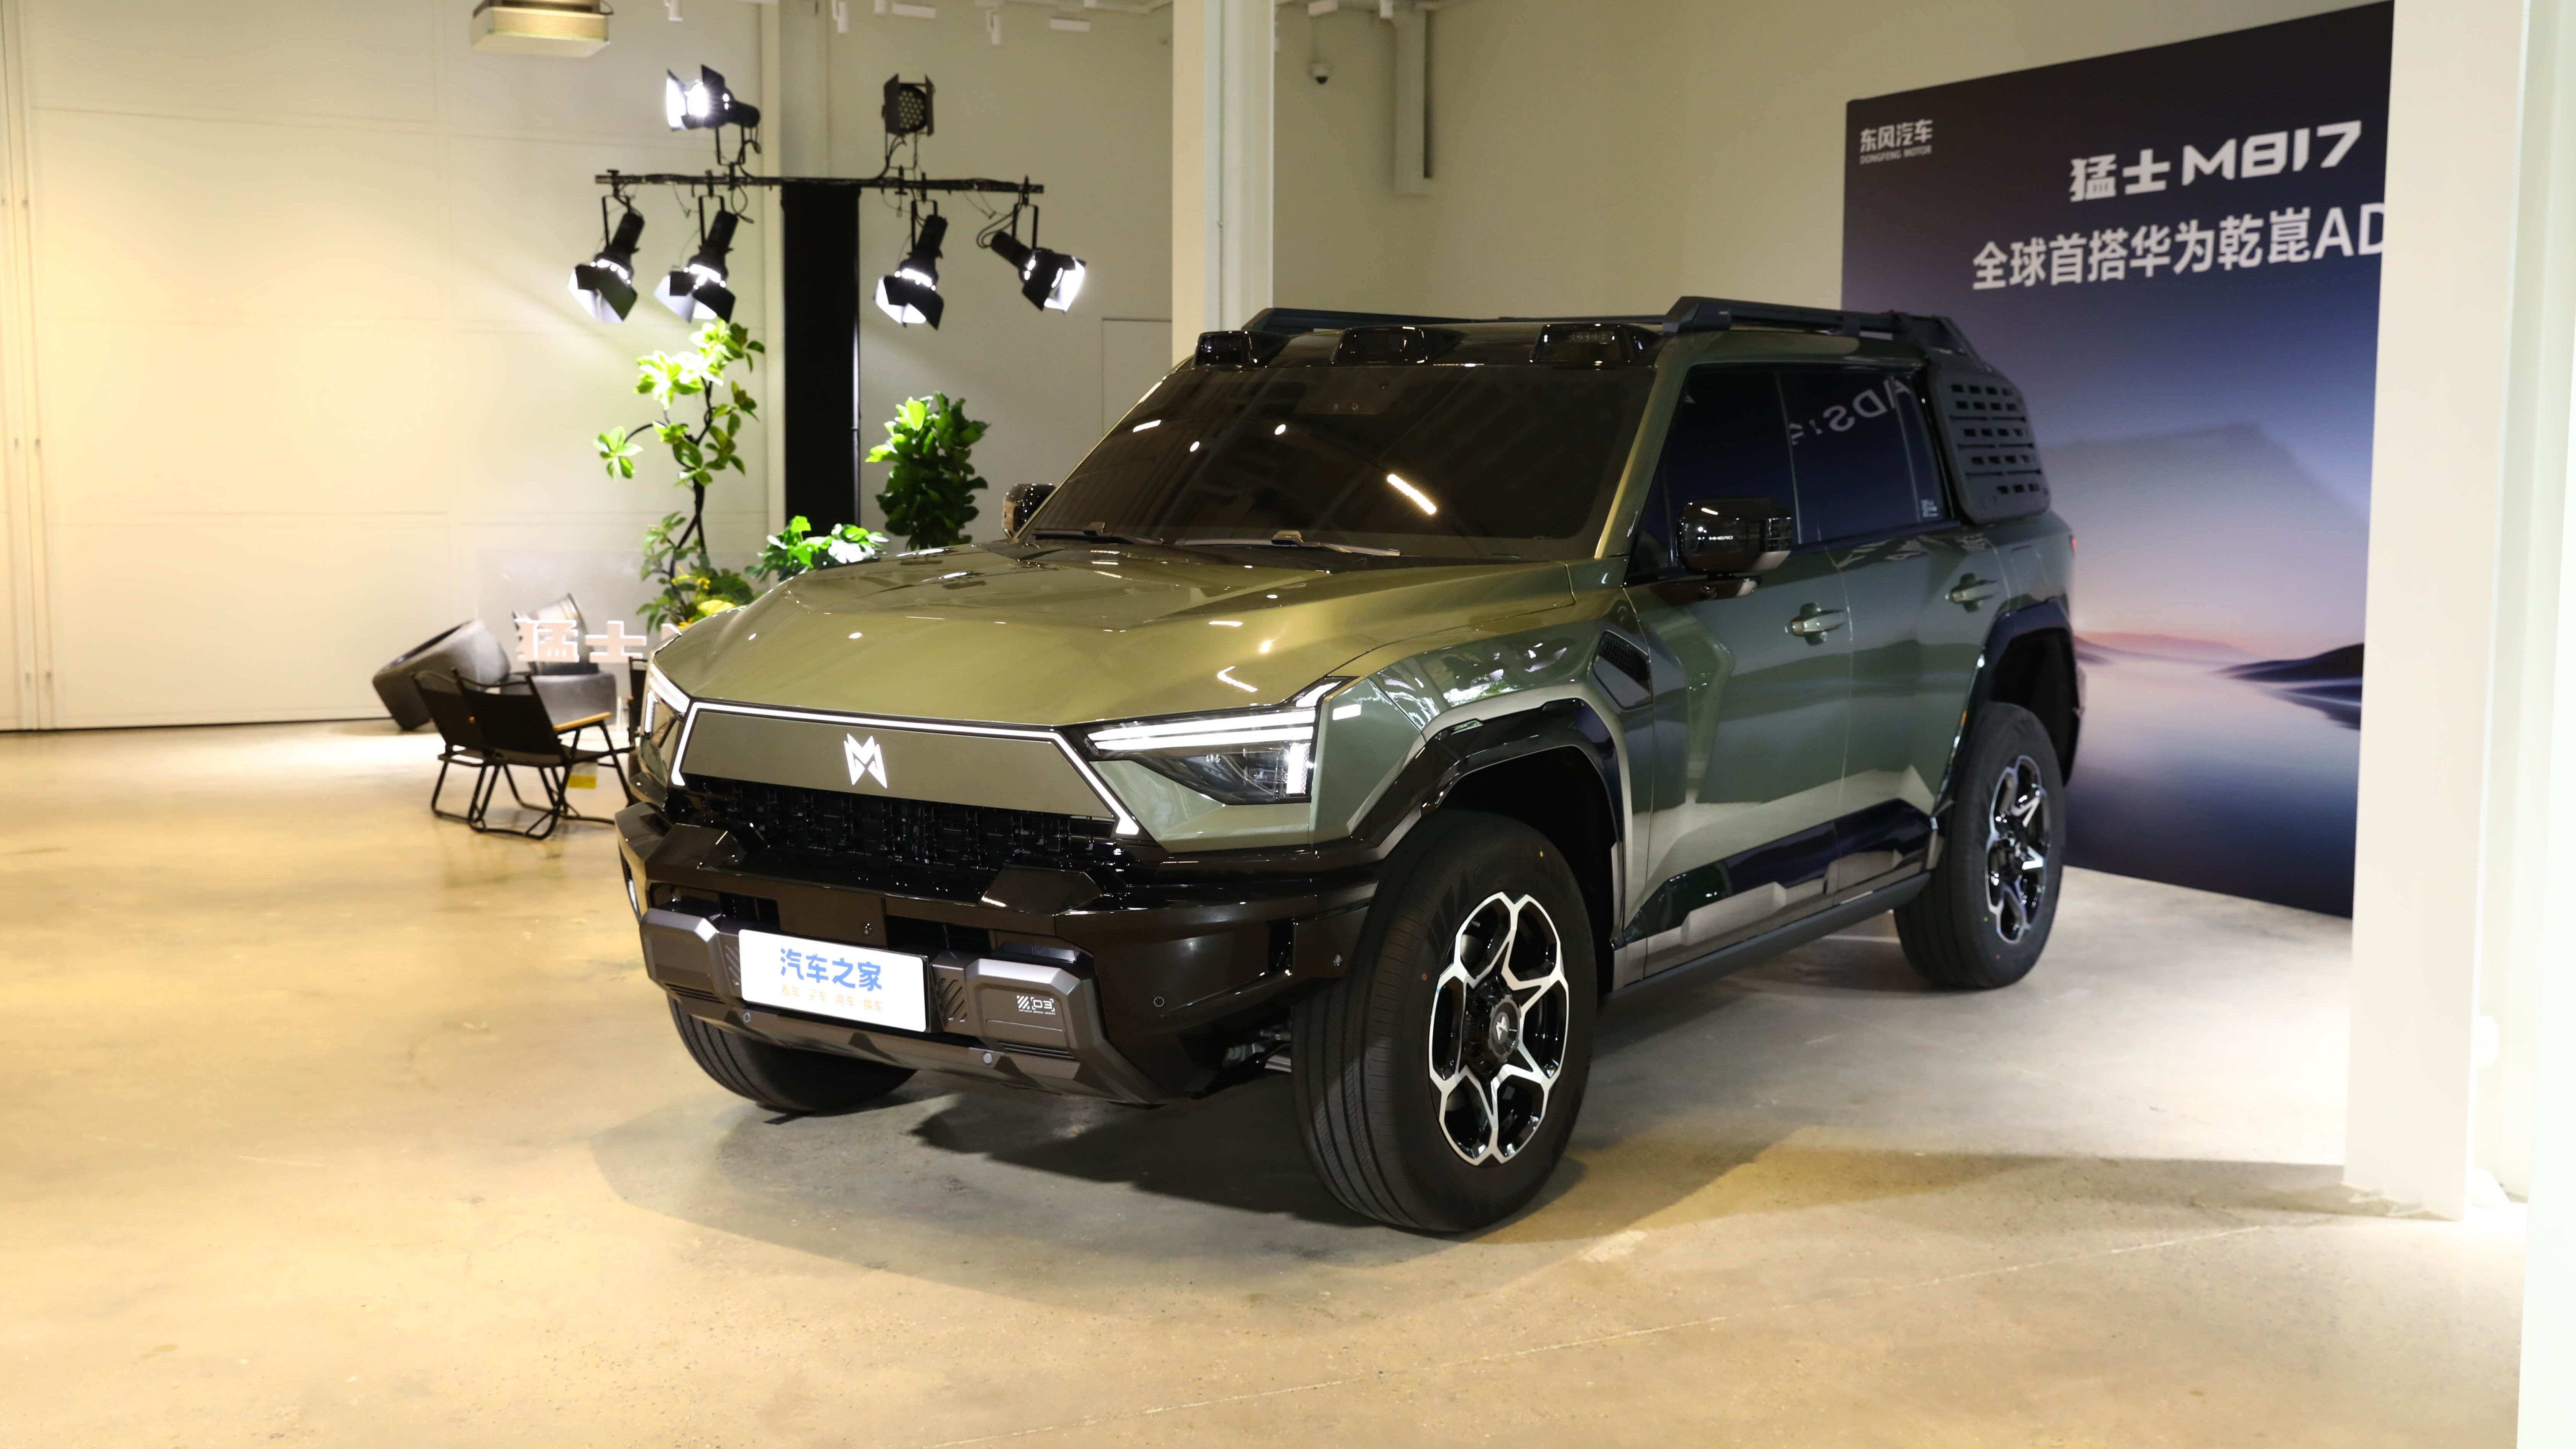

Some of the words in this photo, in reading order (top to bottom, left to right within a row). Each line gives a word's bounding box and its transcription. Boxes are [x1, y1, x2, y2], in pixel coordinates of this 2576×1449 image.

[1860, 119, 1933, 153] 东风汽车
[2069, 148, 2170, 202] 猛士
[2182, 120, 2361, 186] M817
[514, 618, 647, 663] 猛士
[780, 948, 882, 991] 汽车之家
